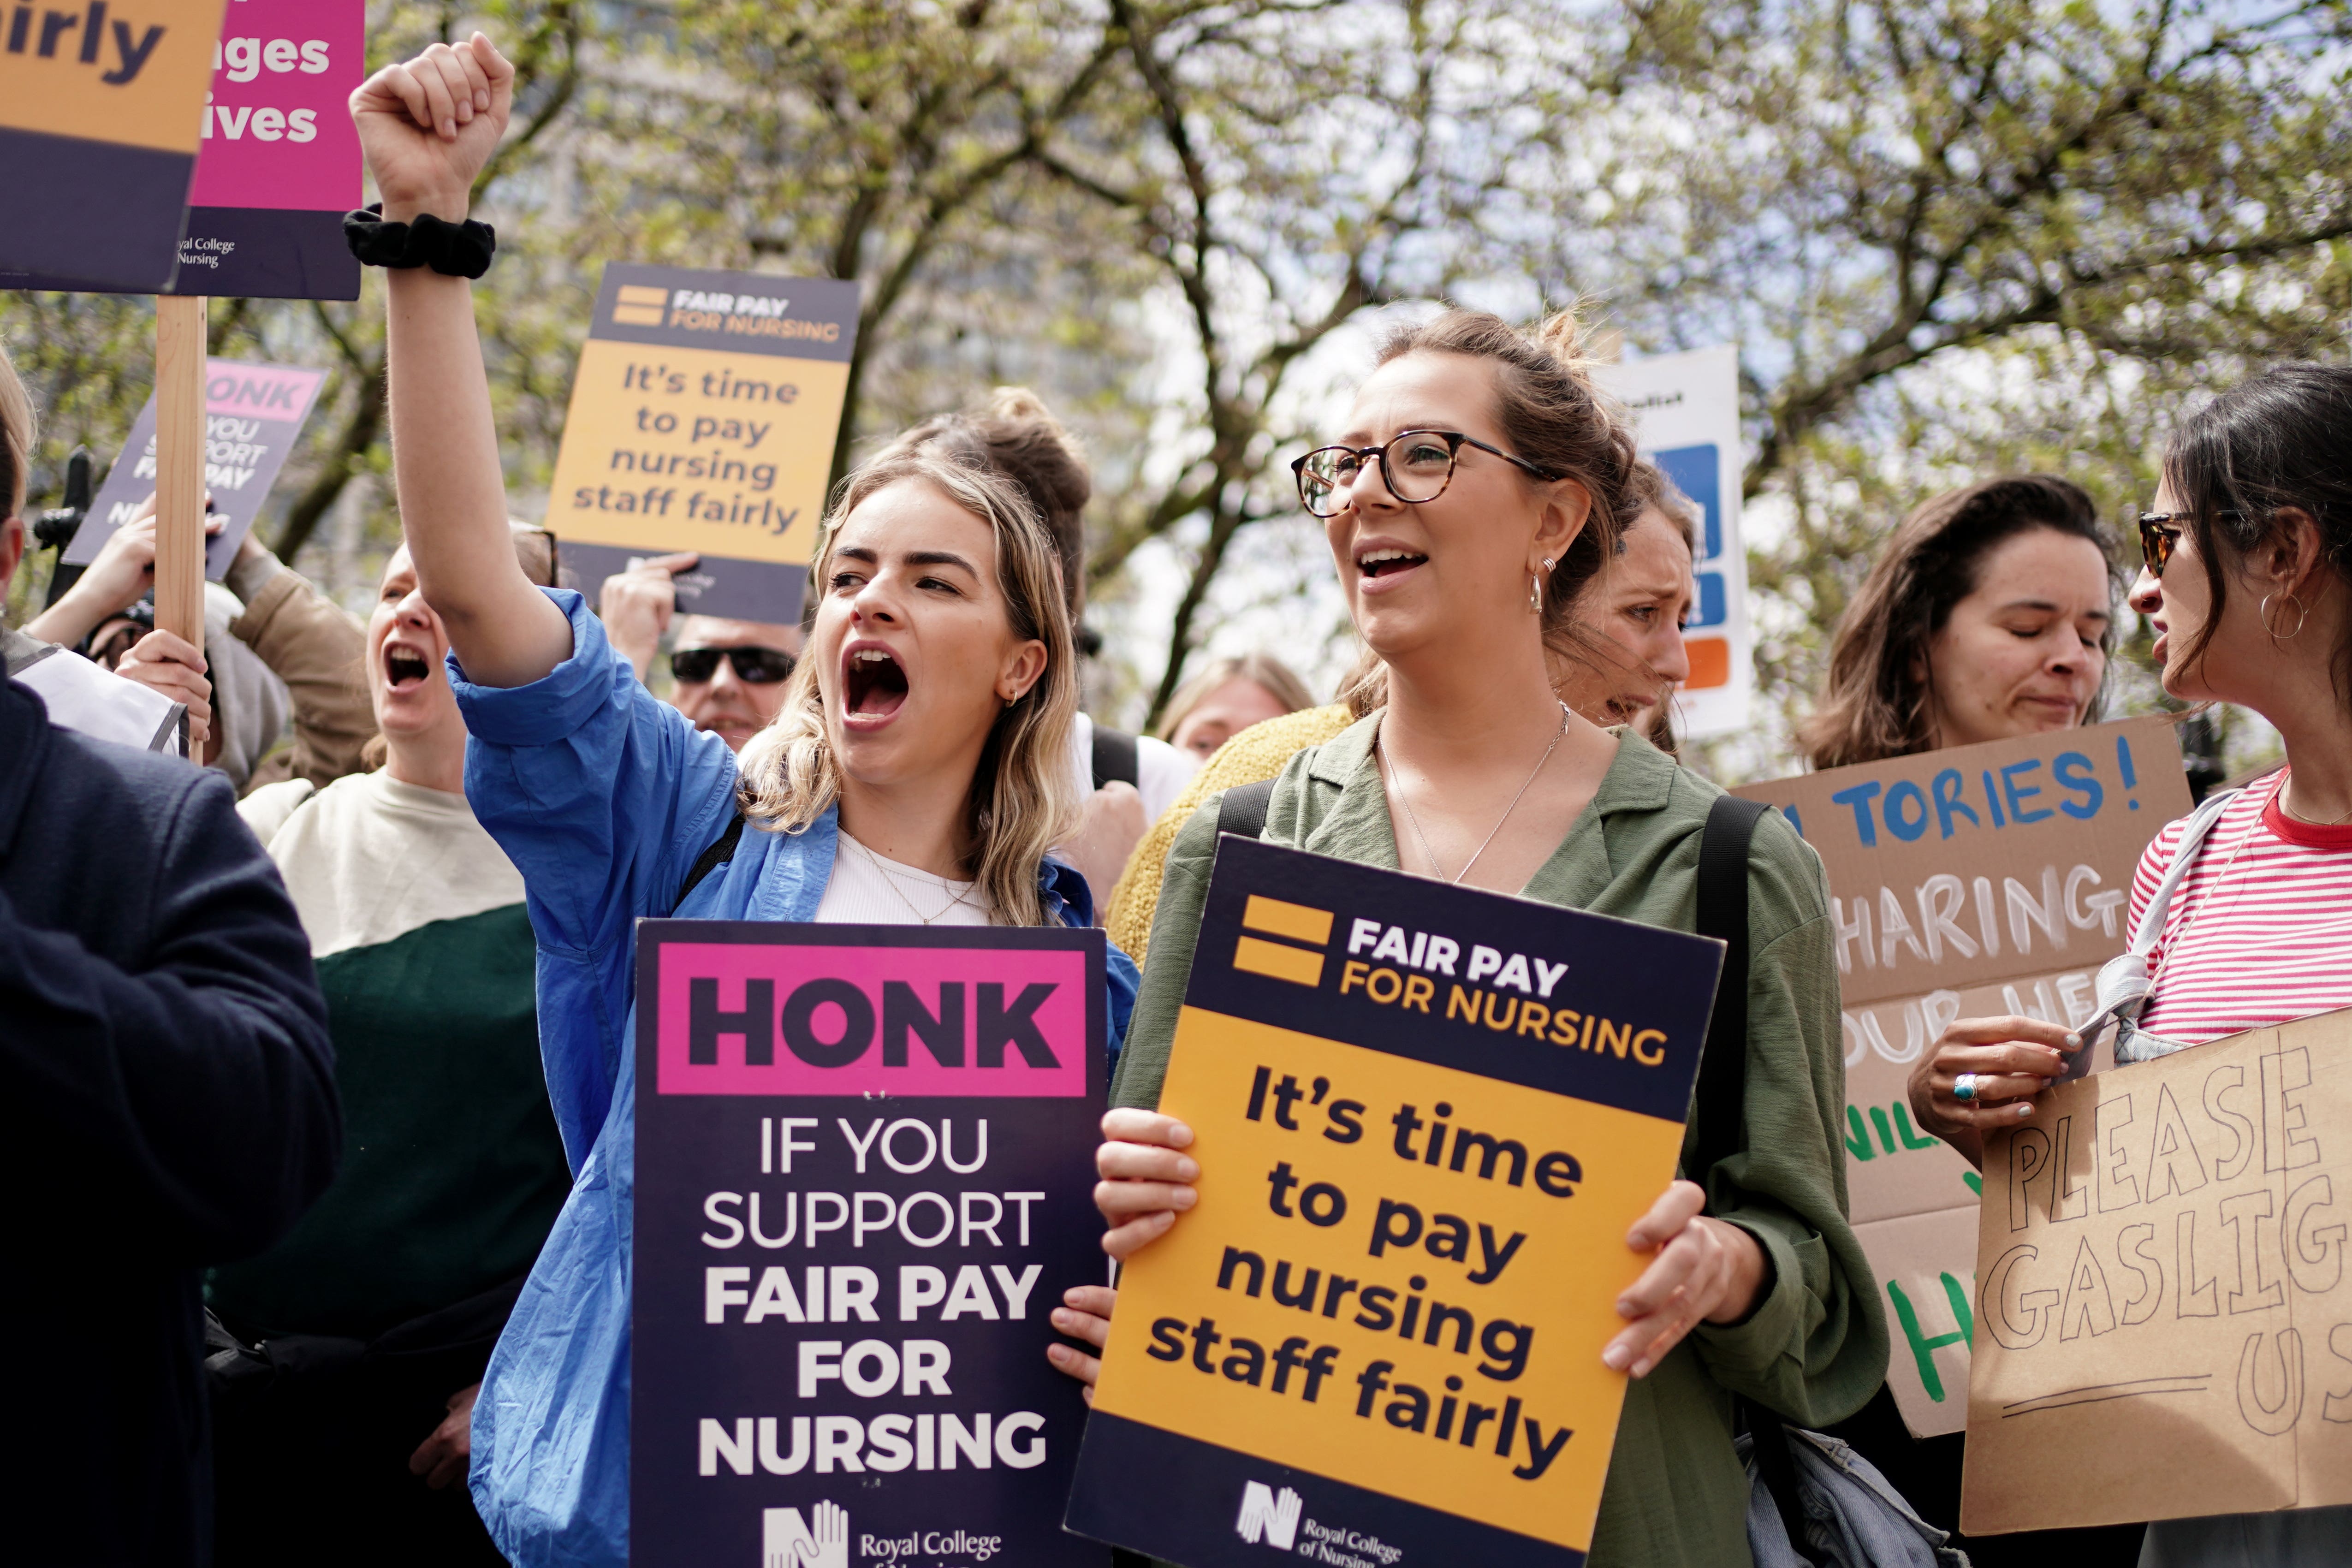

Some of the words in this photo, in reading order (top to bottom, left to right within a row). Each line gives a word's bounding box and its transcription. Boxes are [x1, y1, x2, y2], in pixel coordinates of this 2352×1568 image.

[0, 0, 167, 86] irly
[200, 90, 317, 143] ives
[177, 252, 219, 269] Nursing
[178, 238, 193, 252] yal
[195, 238, 236, 255] College
[669, 309, 721, 333] FOR
[725, 313, 840, 343] NURSING
[672, 290, 734, 313] FAIR
[737, 294, 789, 317] PAY
[206, 376, 302, 410] ONK
[702, 369, 800, 404] time
[636, 407, 677, 433] to
[692, 414, 770, 447] pay
[610, 450, 778, 492] nursing
[574, 486, 675, 517] staff
[687, 491, 799, 535] fairly
[1832, 735, 2138, 847] TORIES!
[1832, 865, 2127, 974] HARING
[1347, 917, 1461, 976] FAIR
[1467, 944, 1568, 997] PAY
[689, 977, 1063, 1069] HONK
[1339, 960, 1435, 1013] FOR
[1446, 984, 1668, 1066] NURSING
[761, 1117, 818, 1174] IF
[837, 1117, 987, 1174] YOU
[1391, 1101, 1583, 1198] time
[2010, 1046, 2321, 1233] PLEASE
[701, 1191, 1045, 1249] SUPPORT
[1267, 1162, 1347, 1227] to
[1368, 1196, 1528, 1285] pay
[705, 1266, 880, 1324] FAIR
[899, 1265, 1043, 1321] PAY
[1216, 1245, 1535, 1382] nursing
[798, 1339, 952, 1398] FOR
[1146, 1316, 1342, 1404] staff
[1356, 1359, 1574, 1481] fairly
[699, 1411, 1046, 1476] NURSING
[861, 1531, 919, 1564] Royal
[924, 1530, 1001, 1561] College
[1298, 1540, 1318, 1558] of
[1303, 1518, 1347, 1546] Royal
[1347, 1531, 1403, 1565] College
